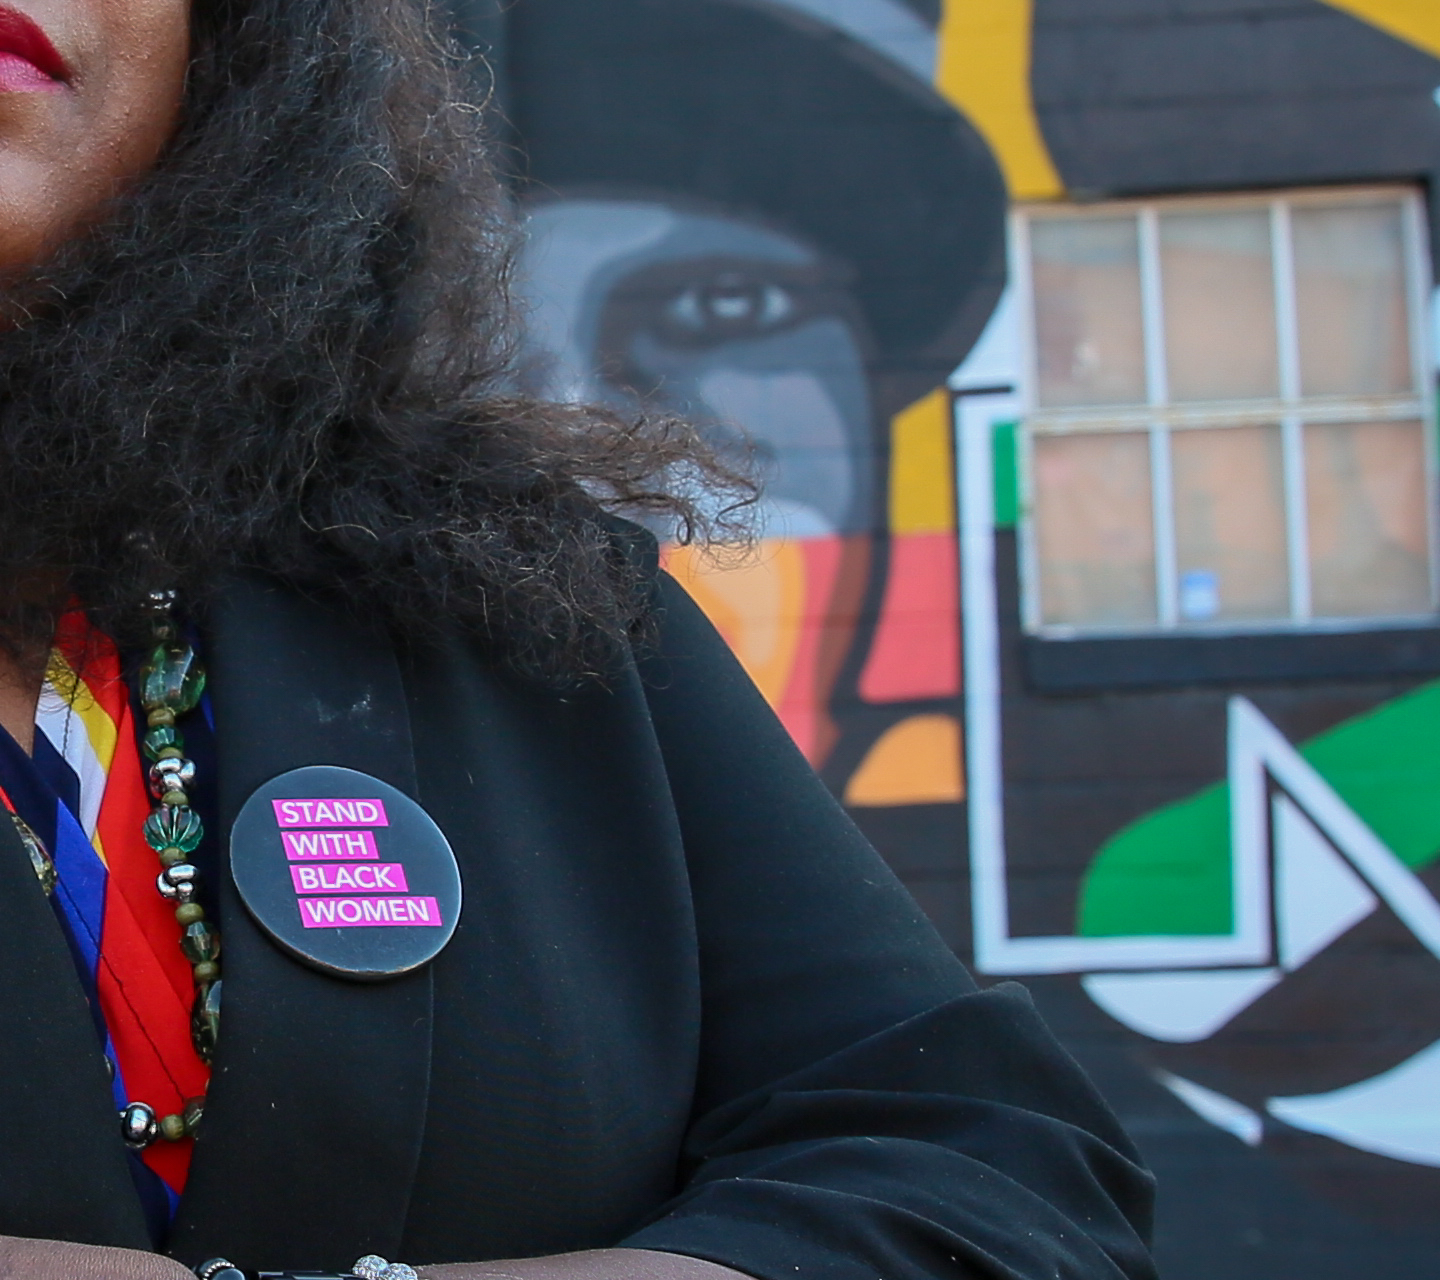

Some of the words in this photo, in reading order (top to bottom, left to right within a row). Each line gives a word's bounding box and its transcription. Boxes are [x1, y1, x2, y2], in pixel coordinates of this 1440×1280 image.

[281, 800, 379, 825] STAND
[287, 832, 369, 857] WITH
[297, 865, 397, 890] BLACK
[304, 899, 431, 923] WOMEN
